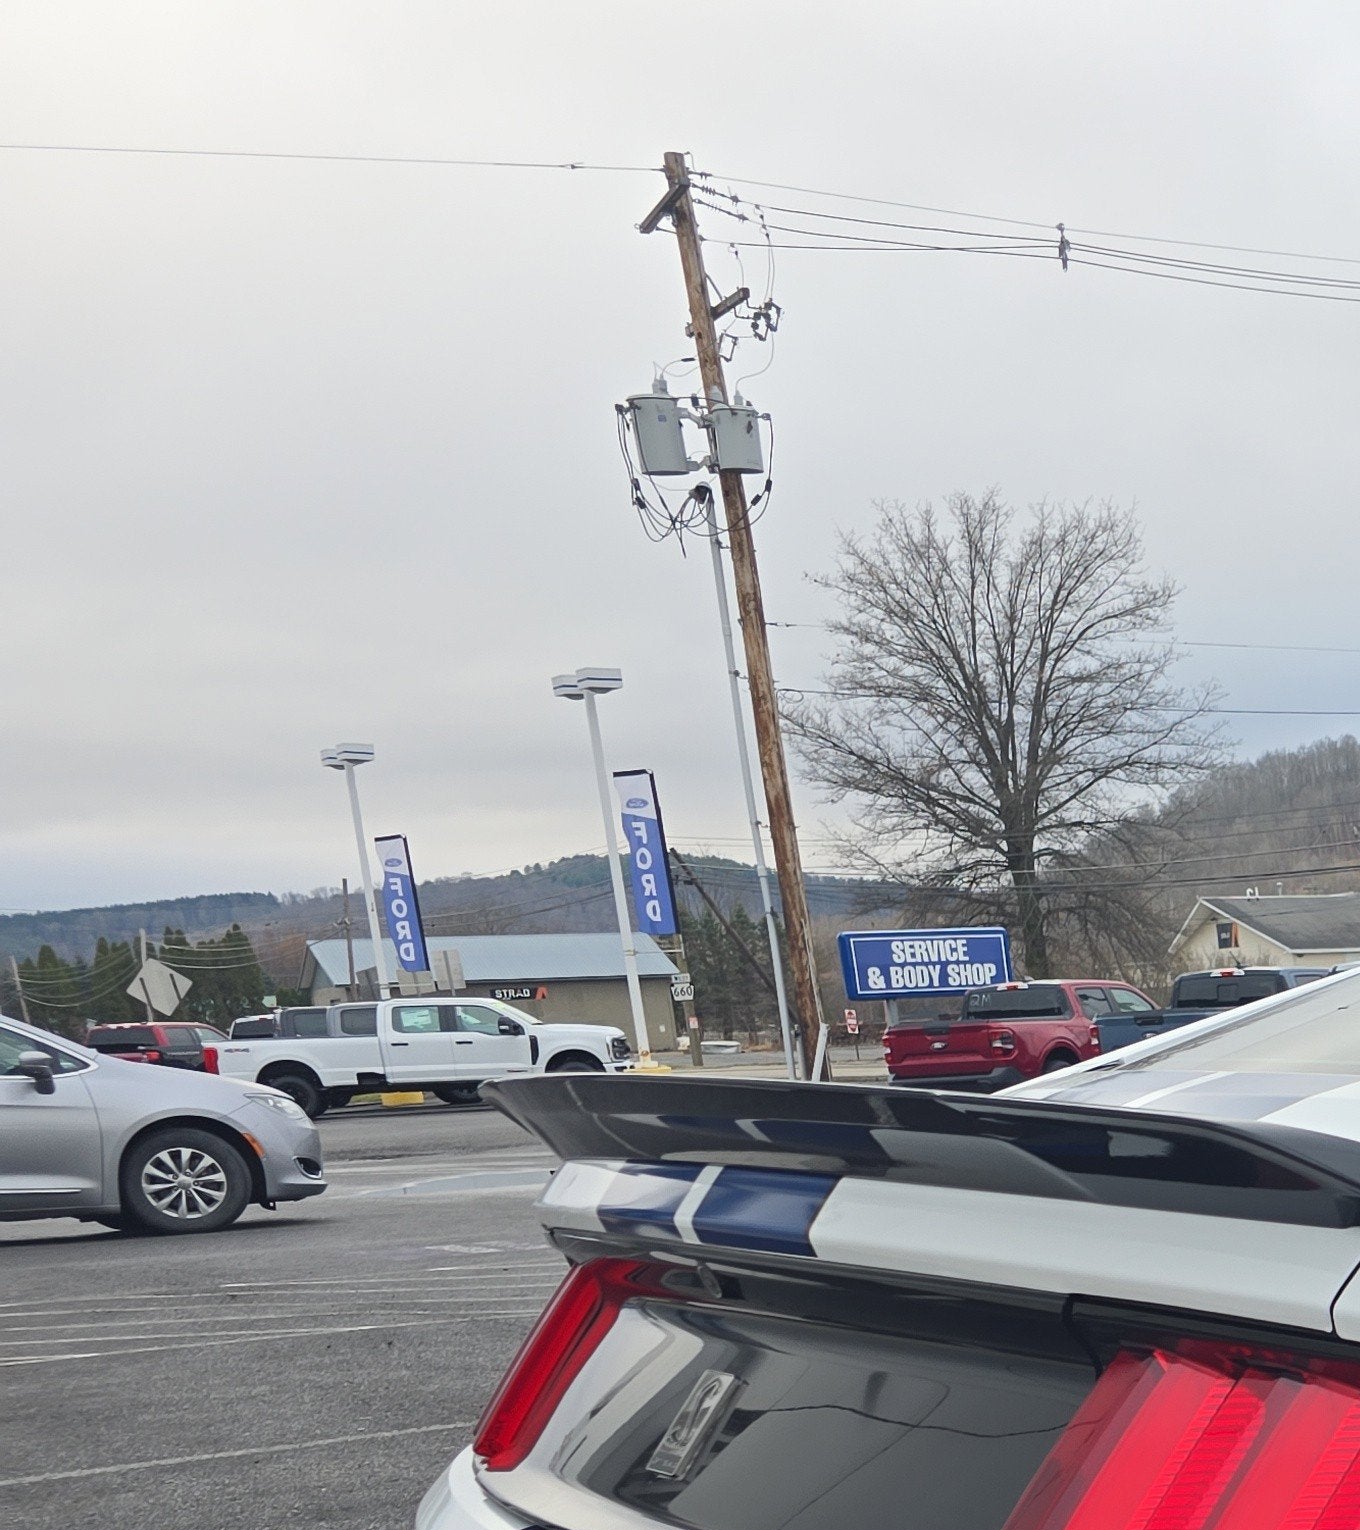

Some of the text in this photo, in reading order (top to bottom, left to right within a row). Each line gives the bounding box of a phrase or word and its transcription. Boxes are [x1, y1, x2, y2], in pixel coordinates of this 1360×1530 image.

[891, 939, 969, 964] SERVICE
[867, 963, 997, 989] & BODY SHOP
[673, 985, 693, 997] 660
